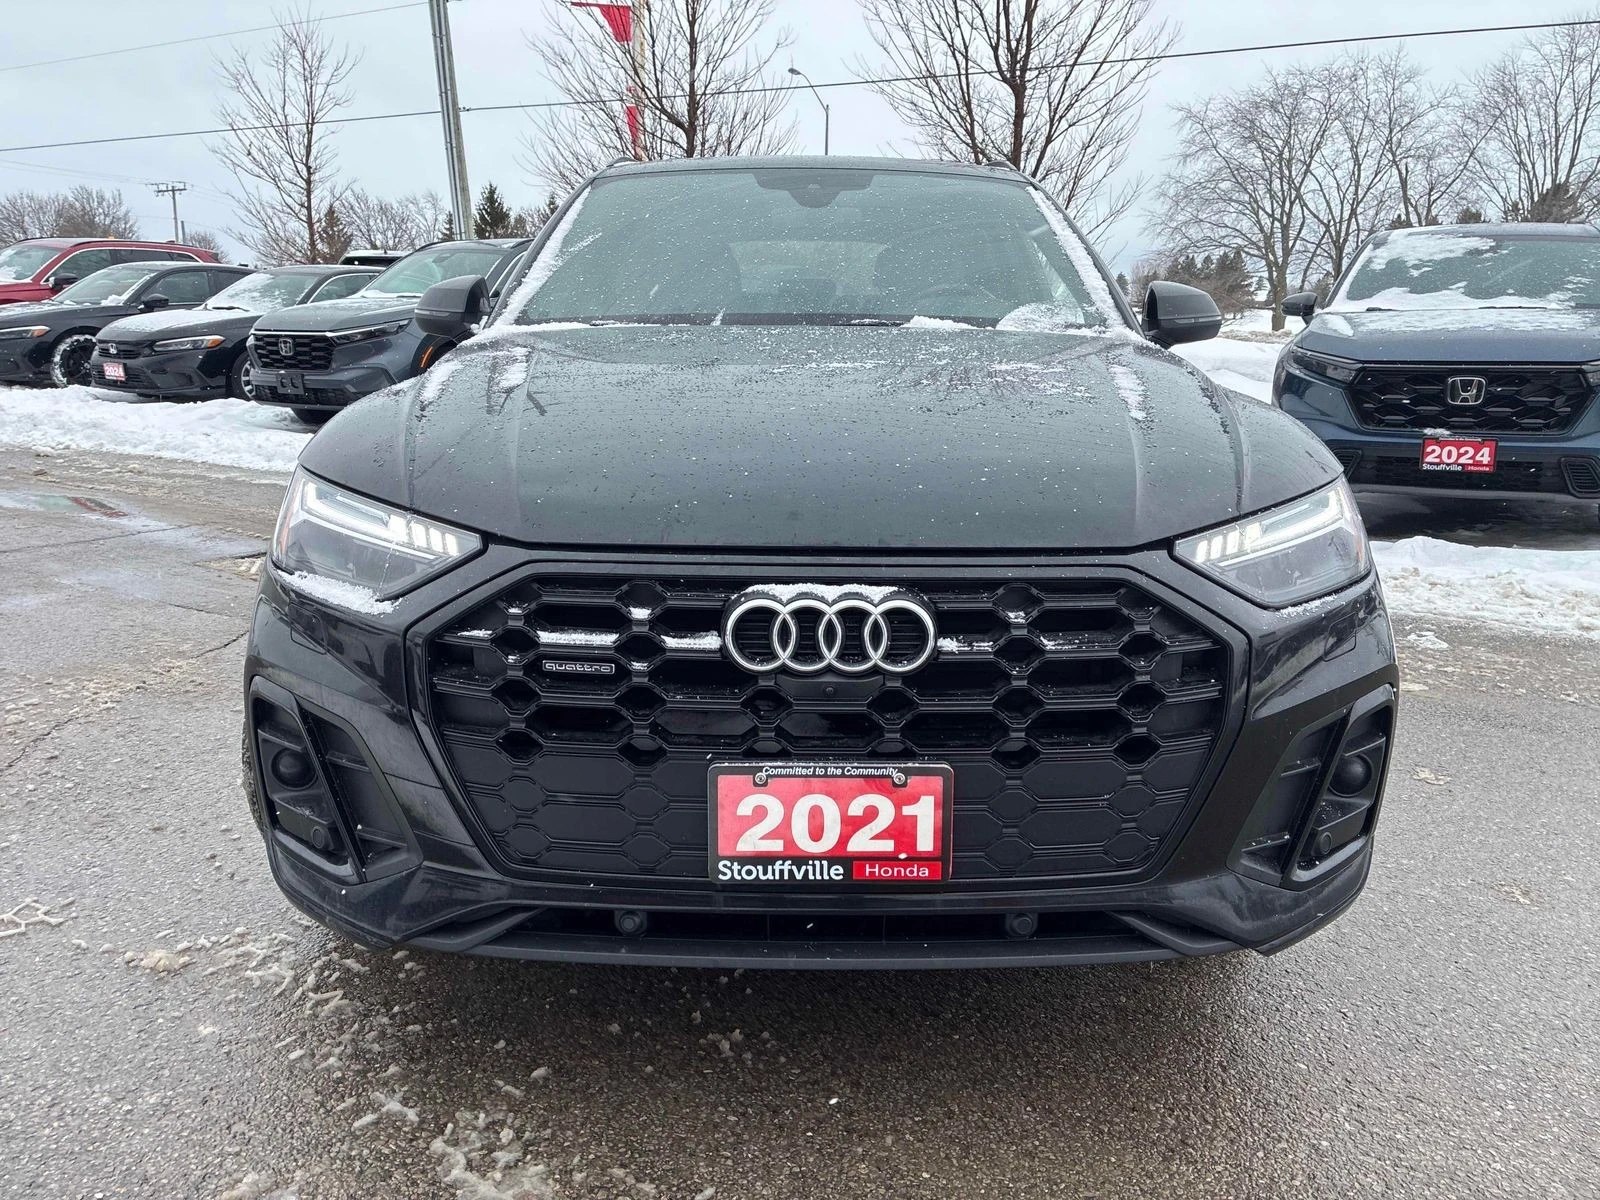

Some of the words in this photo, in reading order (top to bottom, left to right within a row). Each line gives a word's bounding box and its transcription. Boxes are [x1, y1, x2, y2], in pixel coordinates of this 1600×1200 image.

[1424, 445, 1491, 464] 2024
[1422, 463, 1463, 471] Stouffville
[545, 663, 611, 671] quattro
[762, 766, 813, 775] Committed
[815, 767, 825, 775] to
[827, 767, 842, 775] the
[844, 767, 898, 778] Community
[736, 793, 935, 853] 2021
[717, 860, 844, 881] Stouffville
[865, 864, 929, 877] Honda
